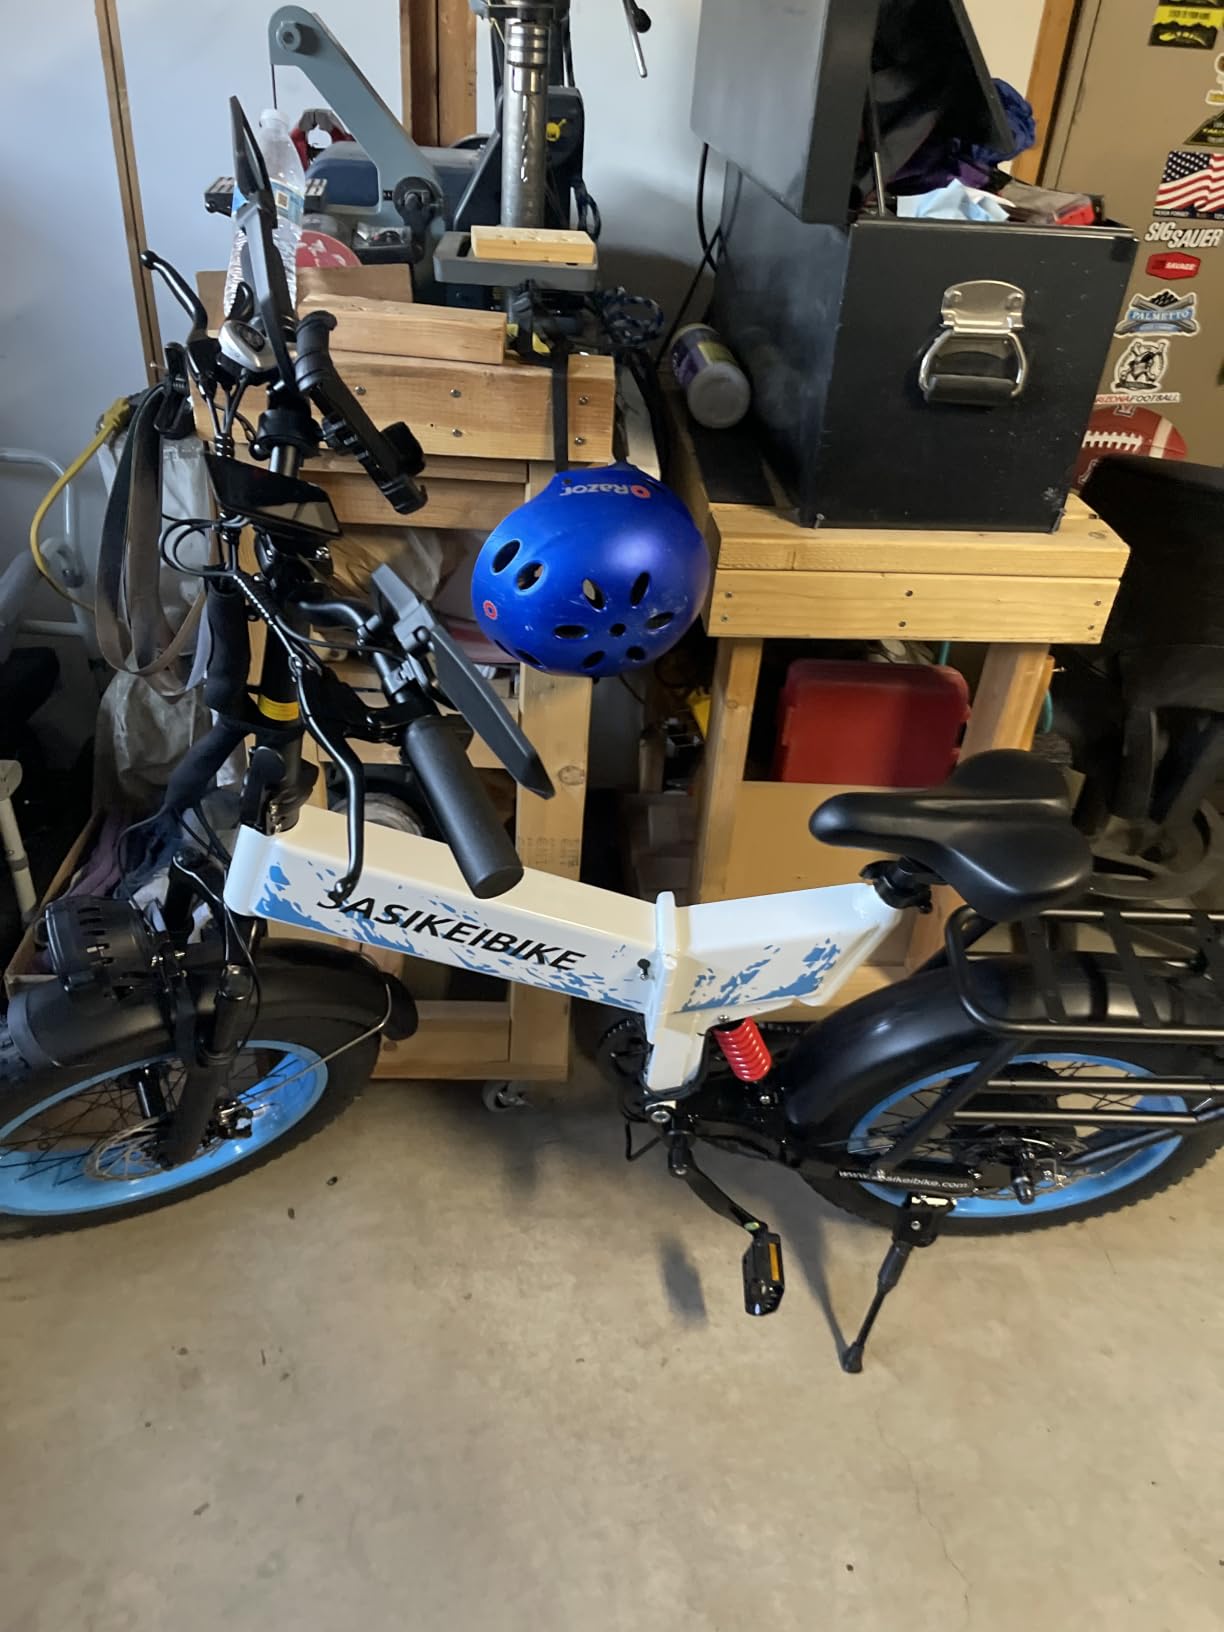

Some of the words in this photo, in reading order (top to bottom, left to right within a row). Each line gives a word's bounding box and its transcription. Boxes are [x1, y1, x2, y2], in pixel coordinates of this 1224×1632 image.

[1144, 221, 1177, 242] SIG
[1167, 228, 1224, 249] SAUER
[1131, 309, 1191, 321] PALMETTO
[559, 483, 629, 497] Razor
